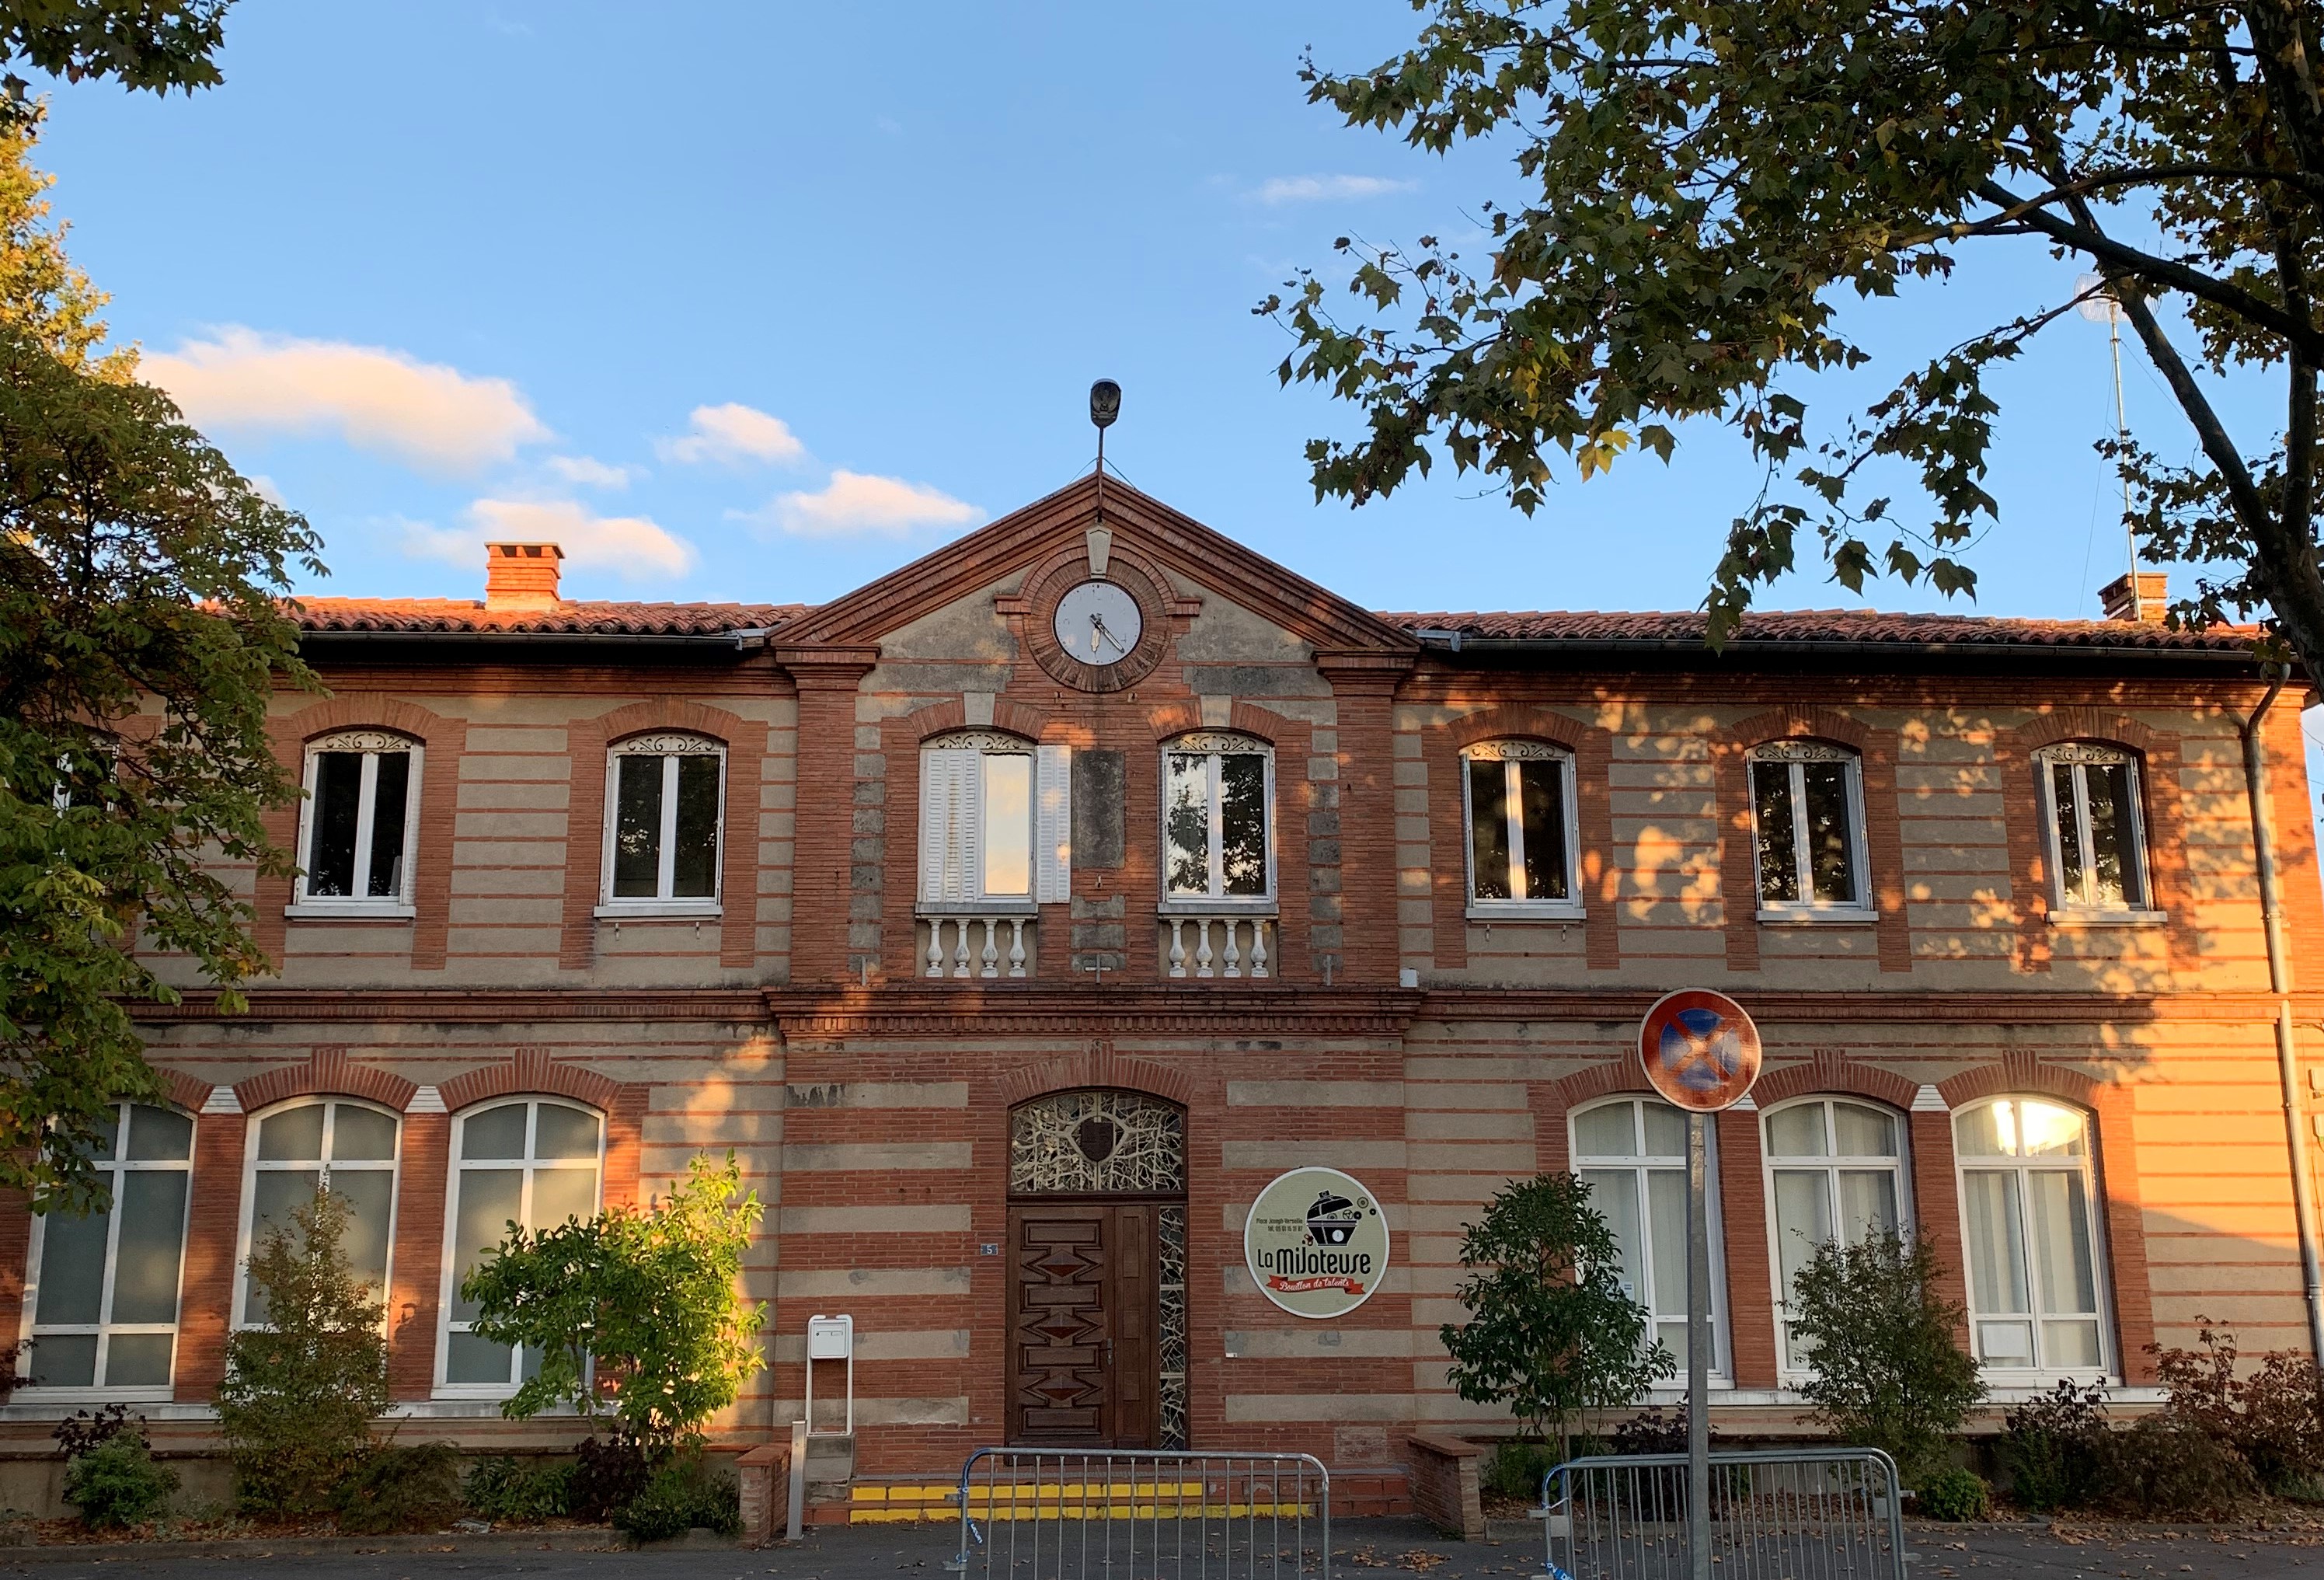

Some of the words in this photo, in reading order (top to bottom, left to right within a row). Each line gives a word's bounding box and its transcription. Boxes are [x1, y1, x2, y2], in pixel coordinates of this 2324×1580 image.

[986, 1245, 993, 1254] 5
[1257, 1248, 1273, 1268] La
[1279, 1281, 1311, 1291] Bouillon
[1313, 1278, 1322, 1288] de
[1322, 1278, 1349, 1287] talents
